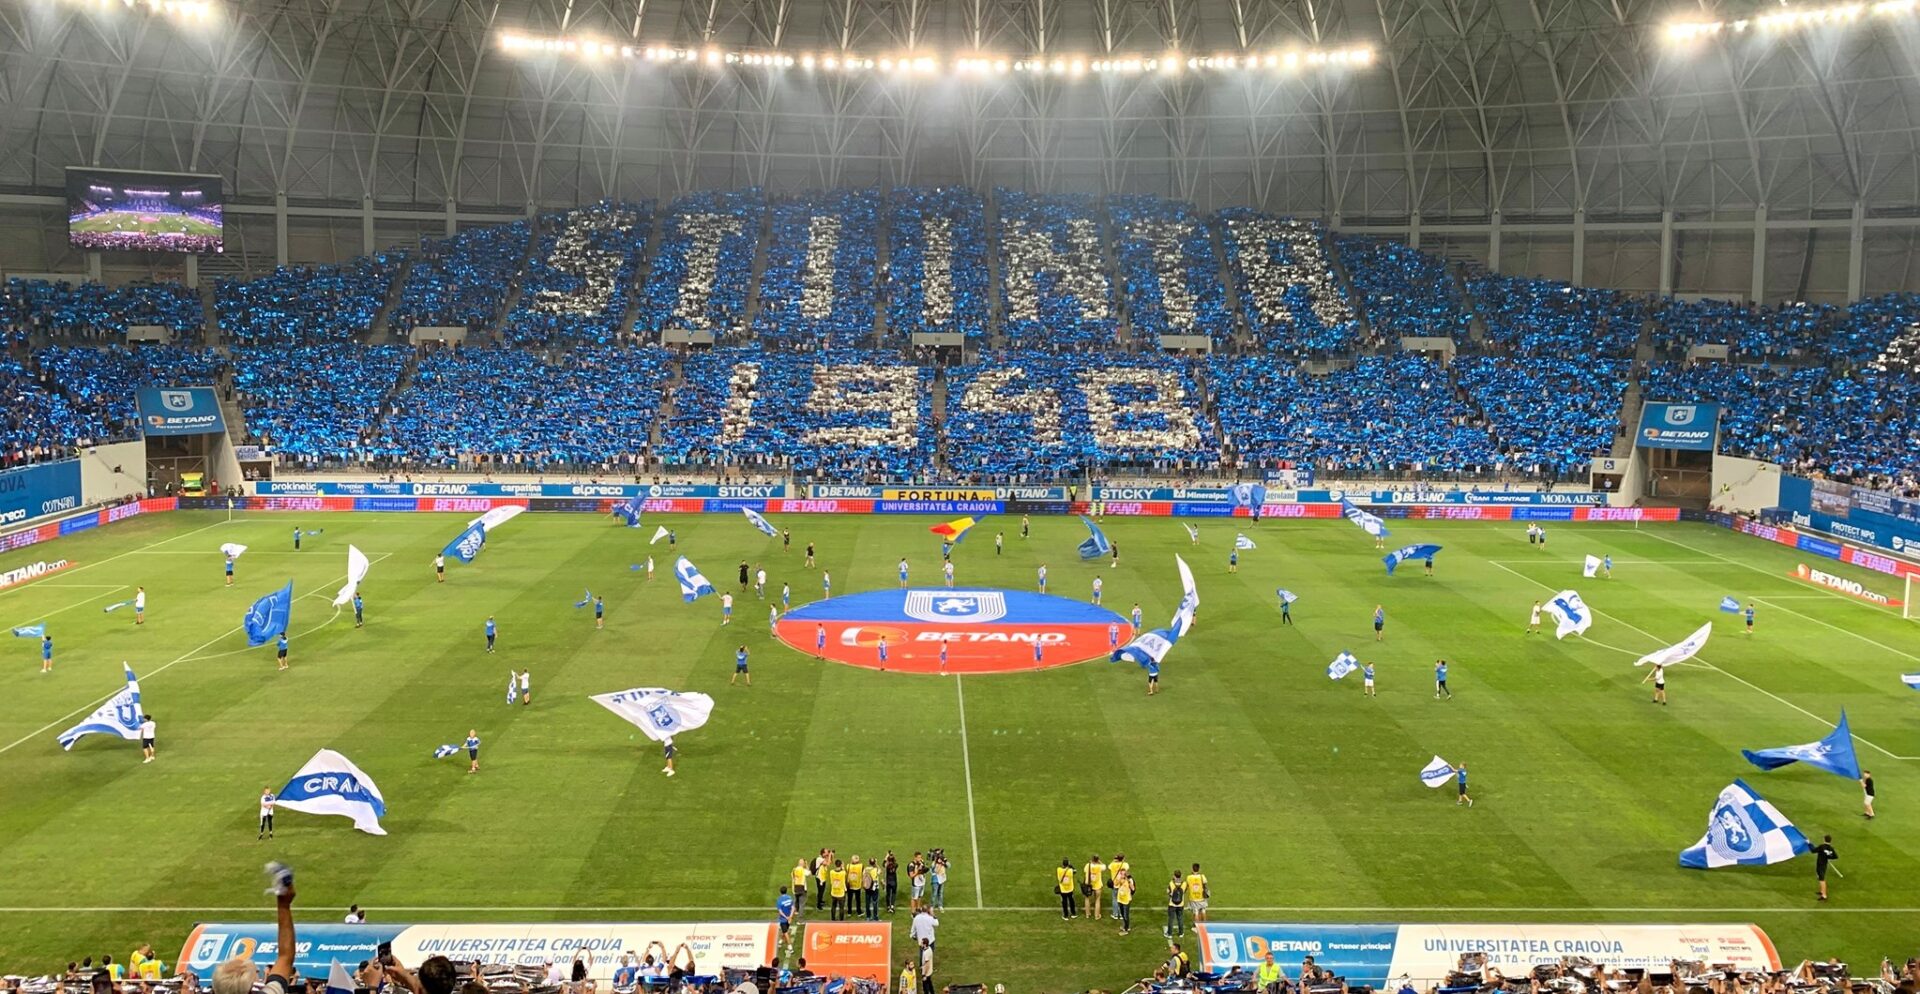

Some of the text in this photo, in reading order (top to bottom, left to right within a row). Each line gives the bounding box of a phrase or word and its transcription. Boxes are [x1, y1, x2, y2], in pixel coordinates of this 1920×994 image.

[167, 415, 216, 424] BETANO
[272, 481, 316, 492] prokinetic
[572, 484, 623, 496] elpreco
[718, 486, 773, 497] STICKY
[1100, 489, 1153, 500] STICKY
[1540, 494, 1571, 503] MODA
[433, 499, 491, 511] BETANO
[782, 500, 838, 512] BETANO
[882, 502, 997, 511] UNIVERSITATEA CRAIOVA
[108, 502, 140, 523] BETANO
[1588, 508, 1643, 520] BETANO
[1793, 510, 1810, 527] Coral
[1831, 521, 1860, 536] PROTECT
[1853, 549, 1897, 575] BETANO
[915, 632, 1066, 643] BETANO
[417, 938, 623, 951] UNIVERSITATEA CRAIOVA
[834, 934, 883, 944] BETANO
[256, 942, 312, 953] BETNO
[350, 943, 377, 952] princip
[692, 942, 710, 950] Coral
[1271, 940, 1391, 952] BETANO Partener principal
[1424, 939, 1624, 953] UNIVERSITATEA CRAIOVA
